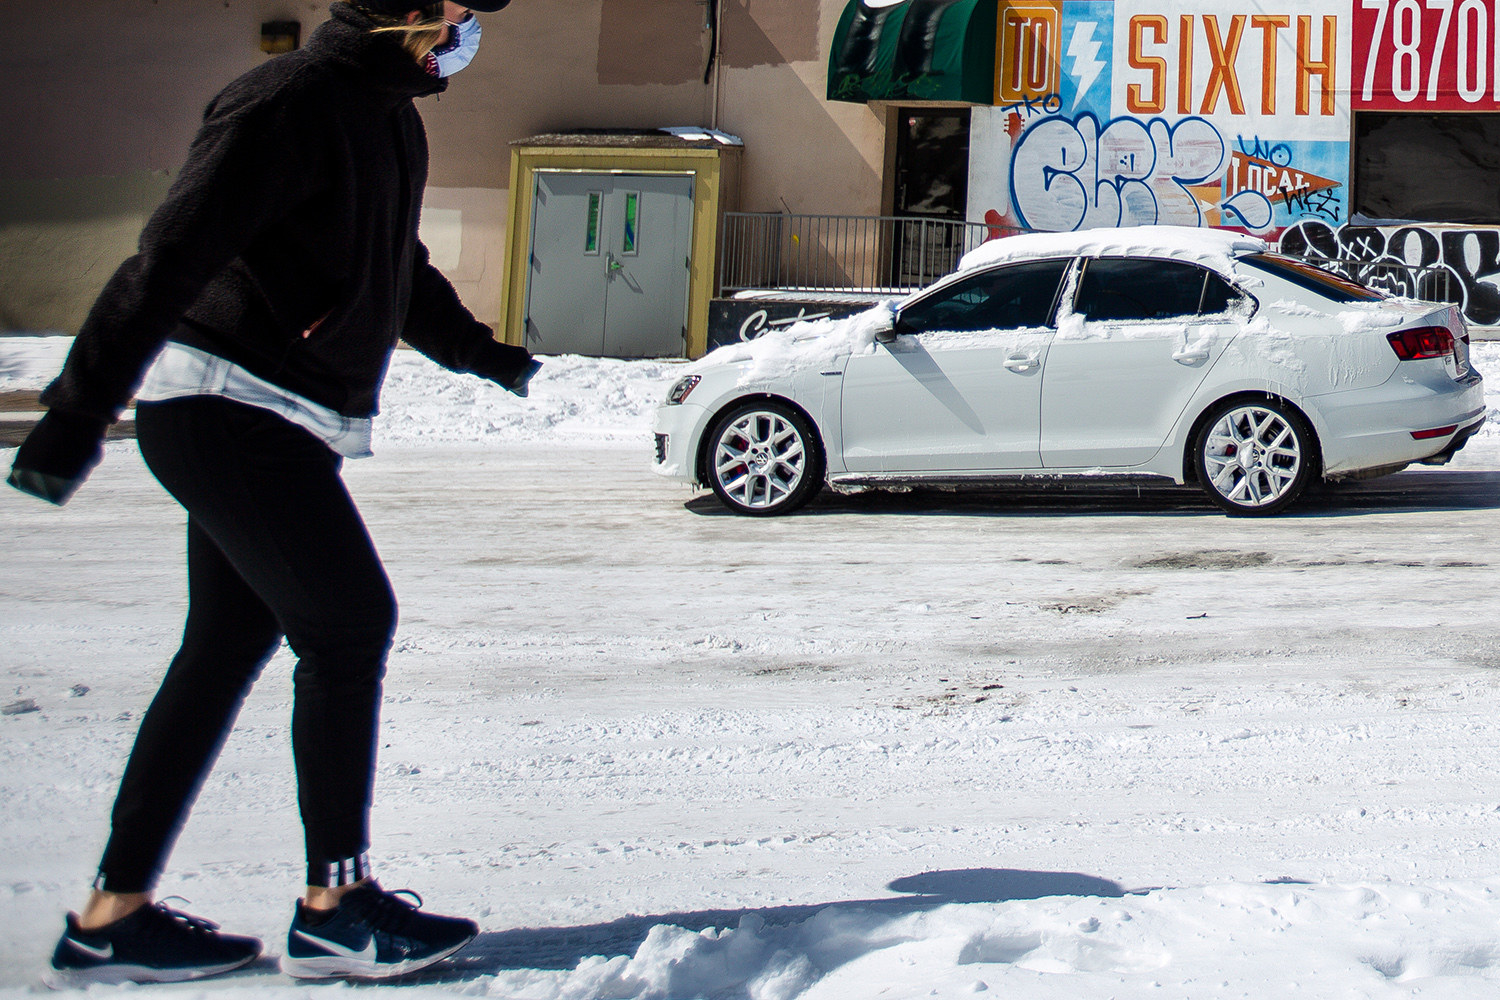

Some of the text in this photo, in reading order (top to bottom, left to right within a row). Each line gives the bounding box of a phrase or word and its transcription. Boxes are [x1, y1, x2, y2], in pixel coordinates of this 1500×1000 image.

[1006, 14, 1052, 93] TO
[1128, 14, 1336, 116] SIXTH
[1231, 156, 1311, 198] LOCAL
